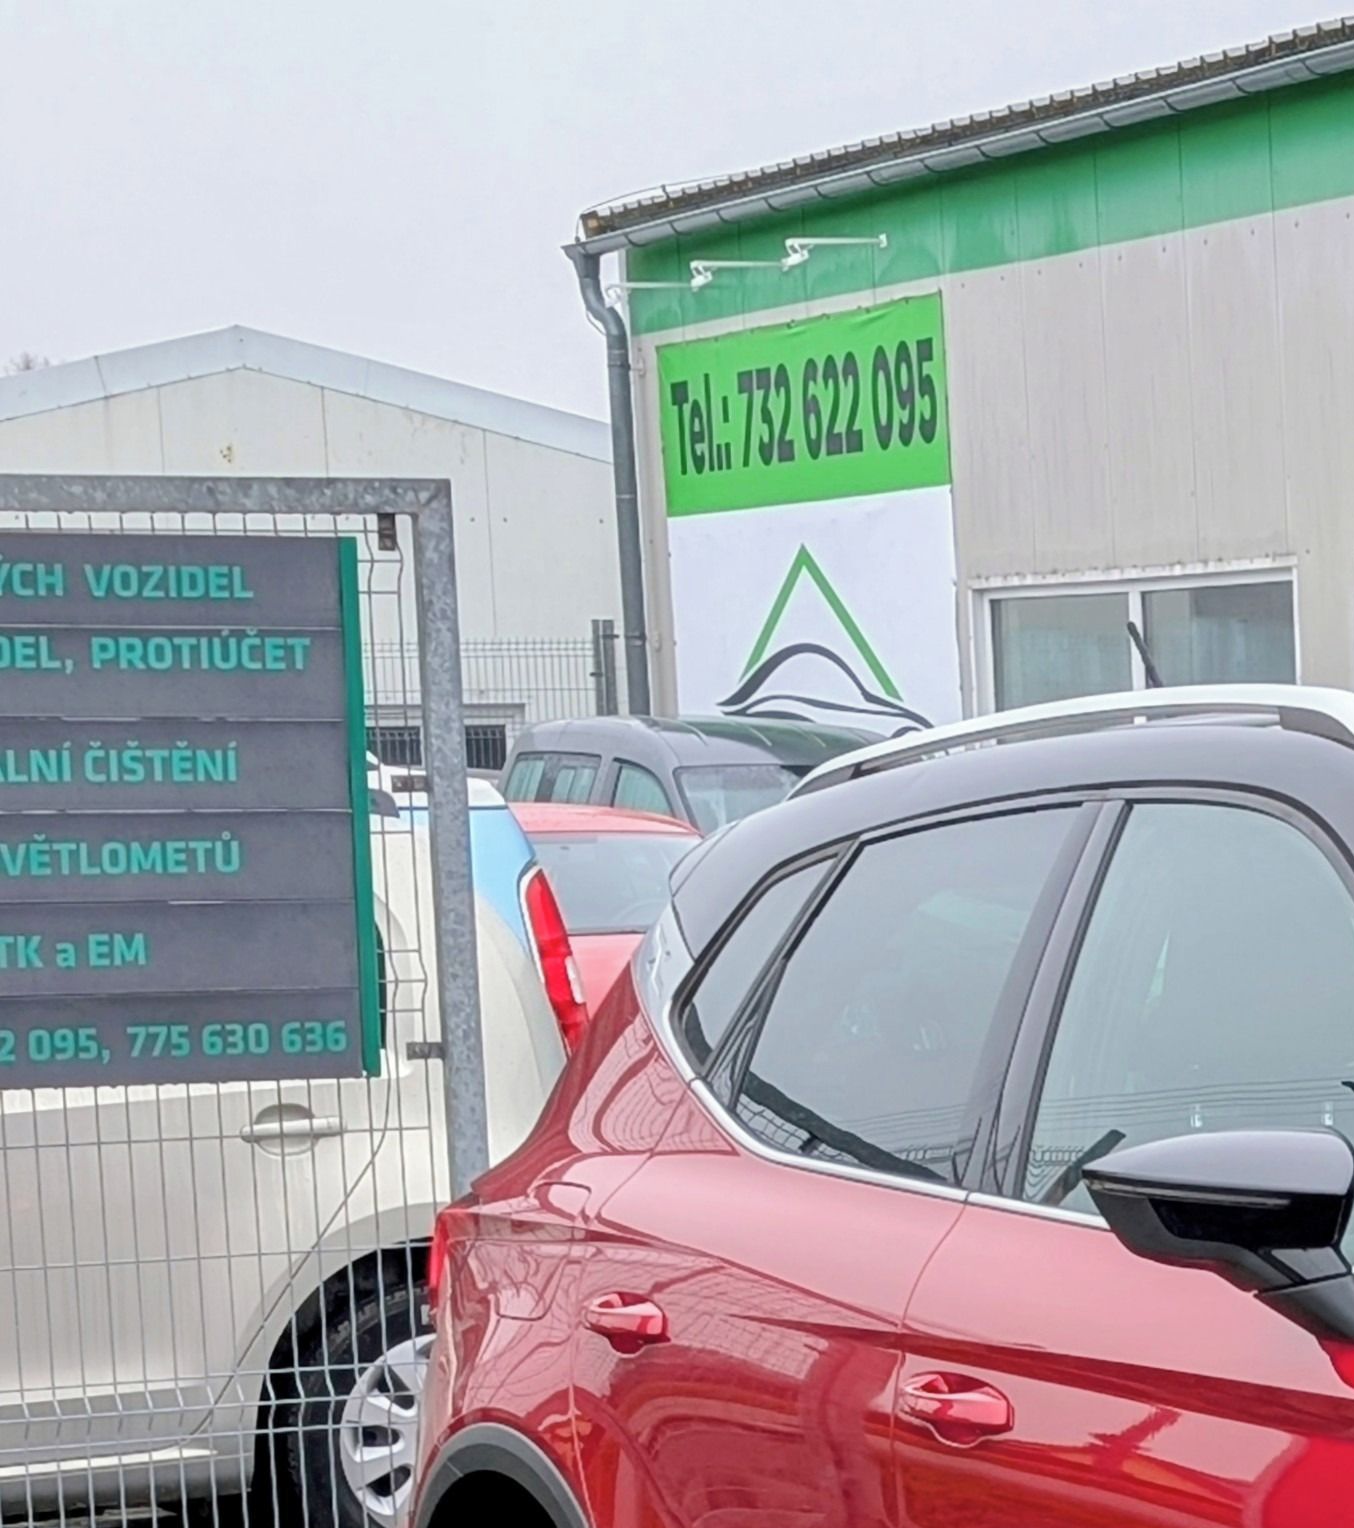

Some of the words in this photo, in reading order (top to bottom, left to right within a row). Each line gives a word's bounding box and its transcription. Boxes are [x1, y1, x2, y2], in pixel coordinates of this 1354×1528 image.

[670, 373, 732, 476] Tel.:
[737, 363, 795, 467] 732
[803, 351, 863, 460] 622
[872, 337, 937, 451] 095
[84, 563, 254, 599] VOZIDEL
[91, 628, 311, 670] PROTIÚČET
[0, 741, 72, 783] LNÍ
[84, 741, 237, 783] ČIŠTĚNÍ
[56, 941, 76, 968] a
[88, 932, 147, 966] EM
[28, 1027, 110, 1064] 095,
[127, 1025, 191, 1058] 775
[202, 1023, 270, 1056] 630
[281, 1021, 347, 1052] 636
